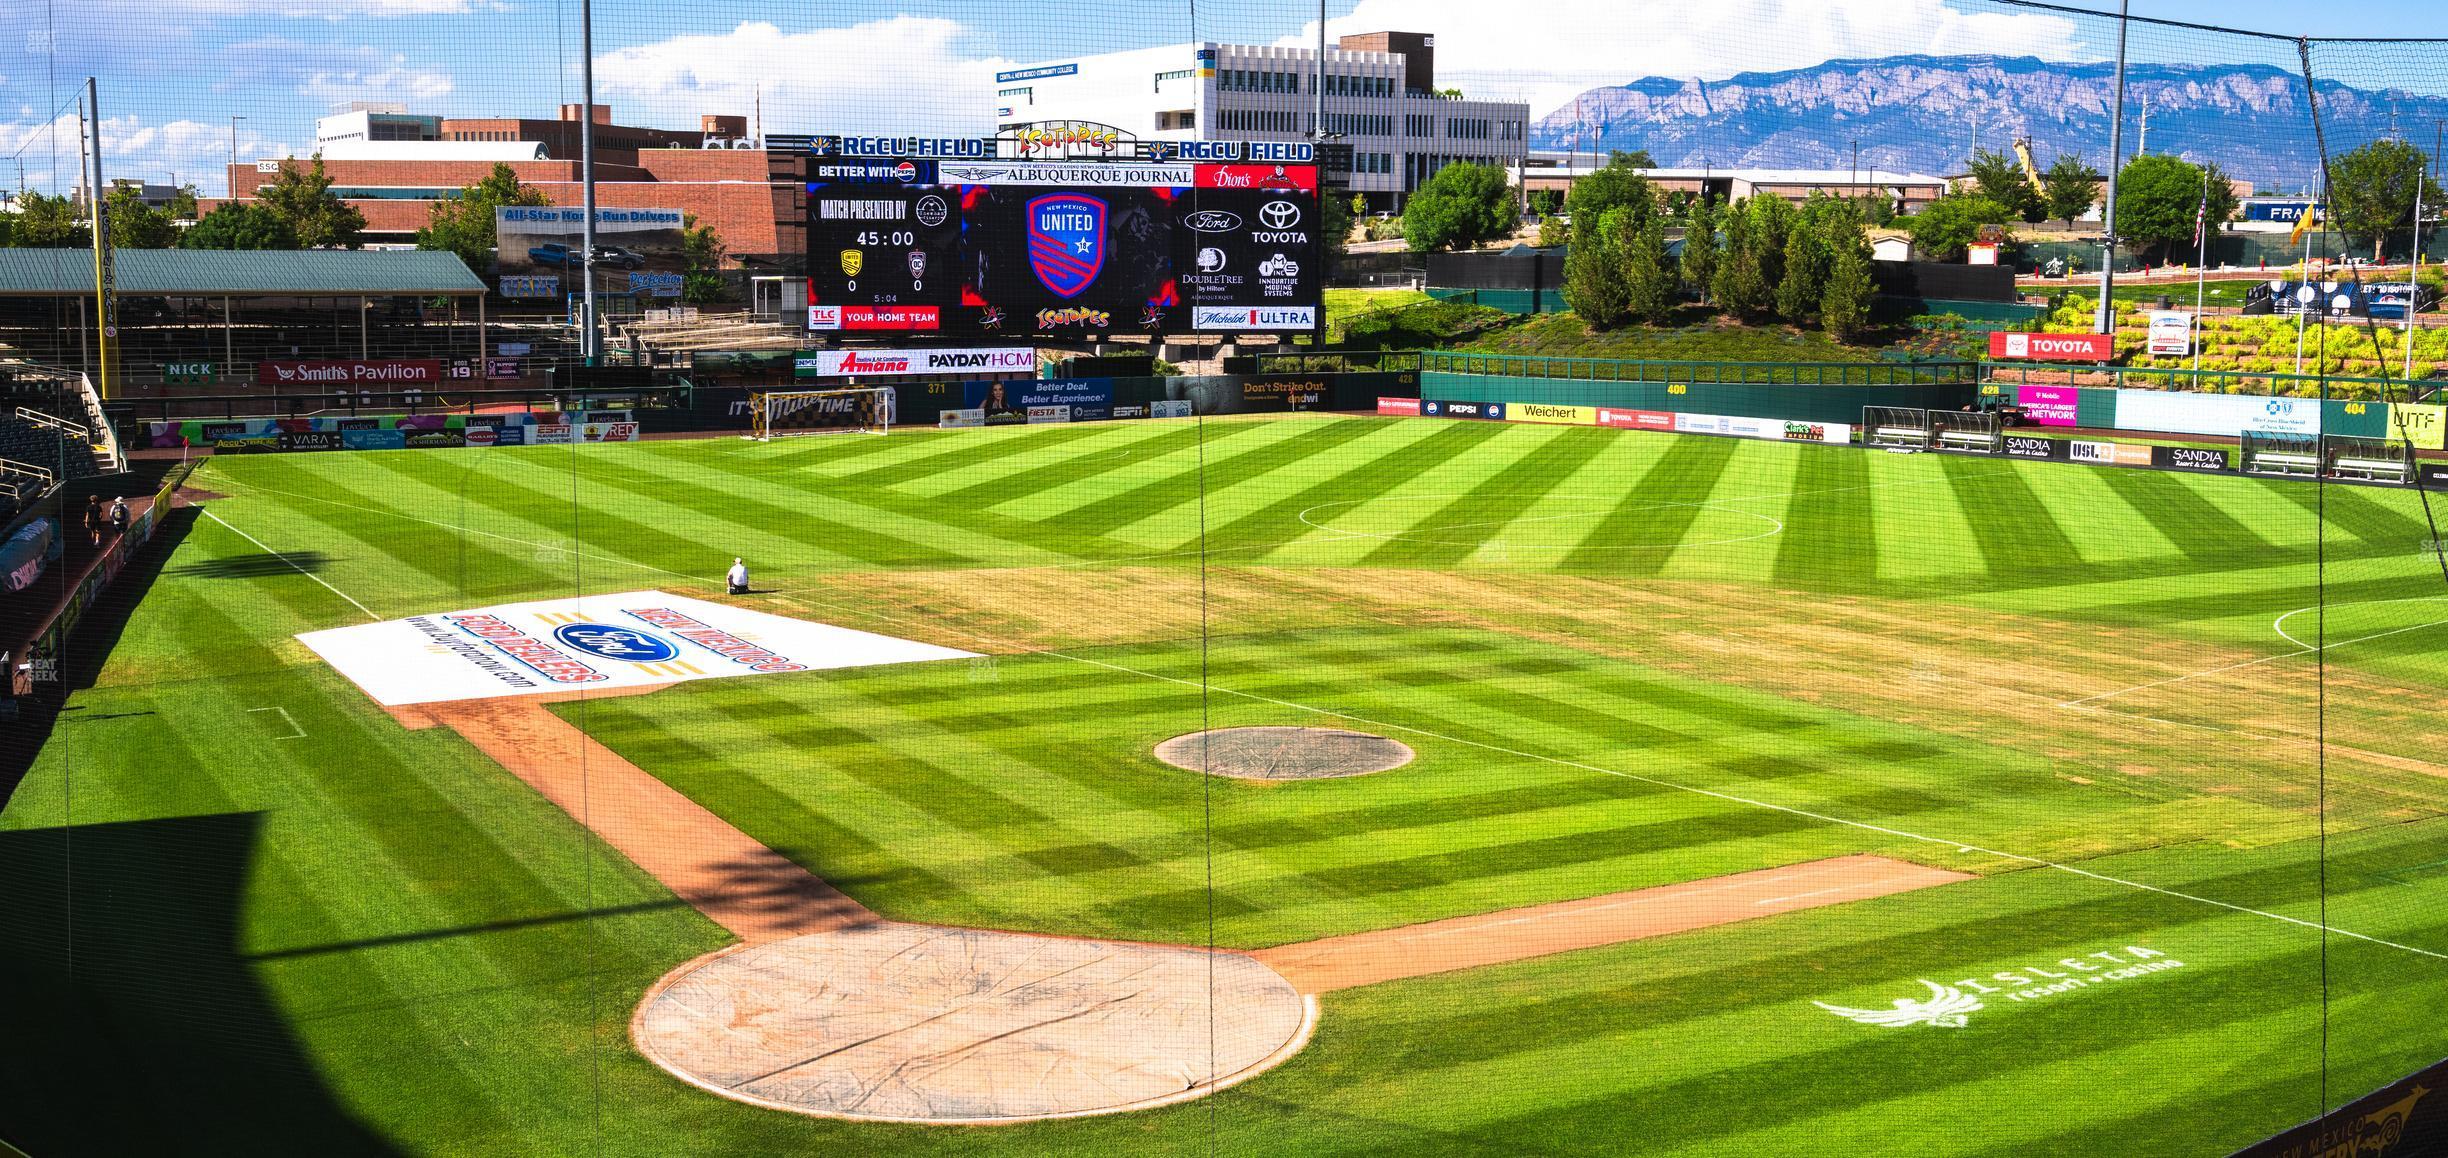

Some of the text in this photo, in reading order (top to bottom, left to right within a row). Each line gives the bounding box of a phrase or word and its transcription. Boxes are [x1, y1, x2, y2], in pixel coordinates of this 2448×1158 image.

[1425, 38, 1434, 46] EC
[1057, 65, 1073, 74] COLLEGE
[1017, 125, 1117, 153] ISOTOPES
[841, 136, 983, 157] RGCU FIELD
[1178, 141, 1313, 161] RGCU FIELD
[819, 165, 897, 177] BETTER WITH
[1007, 169, 1192, 184] ALBUQUERQUE JOURNAL
[1213, 165, 1250, 187] Dion's
[504, 209, 559, 221] All-Star
[602, 211, 628, 221] Run
[630, 210, 680, 222] Drivers
[821, 200, 907, 219] MATCH PRESENTED BY
[1041, 214, 1093, 231] UNITED
[1196, 212, 1230, 229] Ford
[857, 231, 914, 246] 45:00
[1251, 232, 1307, 243] TOYOTA
[1079, 242, 1087, 250] 18
[628, 271, 685, 287] Perfection
[913, 279, 922, 291] 0
[848, 280, 856, 292] 0
[874, 294, 897, 302] 5:04
[813, 310, 835, 318] TLC
[846, 312, 936, 322] YOUR HOME TEAM
[1036, 306, 1110, 329] ISOTOPES
[1198, 312, 1311, 324] Michelob ULTRA
[2031, 340, 2093, 353] TOYOTA
[838, 352, 909, 372] Amana
[928, 353, 1032, 367] PAYDAY HCM
[169, 363, 212, 375] NICK
[297, 364, 426, 381] Smith's Pavilion
[451, 367, 471, 378] 19
[927, 383, 946, 394] 371
[1036, 381, 1089, 392] Better Deal.
[1243, 380, 1327, 393] Don't Strike Out.
[1667, 385, 1687, 394] 400
[1981, 385, 2000, 395] 428
[817, 397, 855, 413] TIME
[1021, 395, 1050, 404] Better
[1029, 408, 1056, 417] FIESTA
[1449, 404, 1477, 414] PEPSI
[1524, 405, 1577, 418] Weichert
[2050, 403, 2076, 411] LARGEST
[2344, 403, 2366, 415] 404
[2031, 410, 2075, 420] NETWORK
[537, 424, 570, 433] ESPN
[609, 424, 634, 436] RED
[1784, 420, 1824, 435] Clark's Pet
[293, 434, 329, 444] VARA
[1783, 432, 1824, 440] EMPORIUM
[2006, 437, 2051, 451] SANDIA
[2172, 448, 2223, 463] SANDIA
[2175, 459, 2195, 467] Resort
[2202, 460, 2221, 469] Casino
[567, 631, 658, 655] Ford
[1955, 945, 2165, 993] ISLETA
[2007, 958, 2184, 1001] resort casino
[2309, 1116, 2366, 1153] MEXICO
